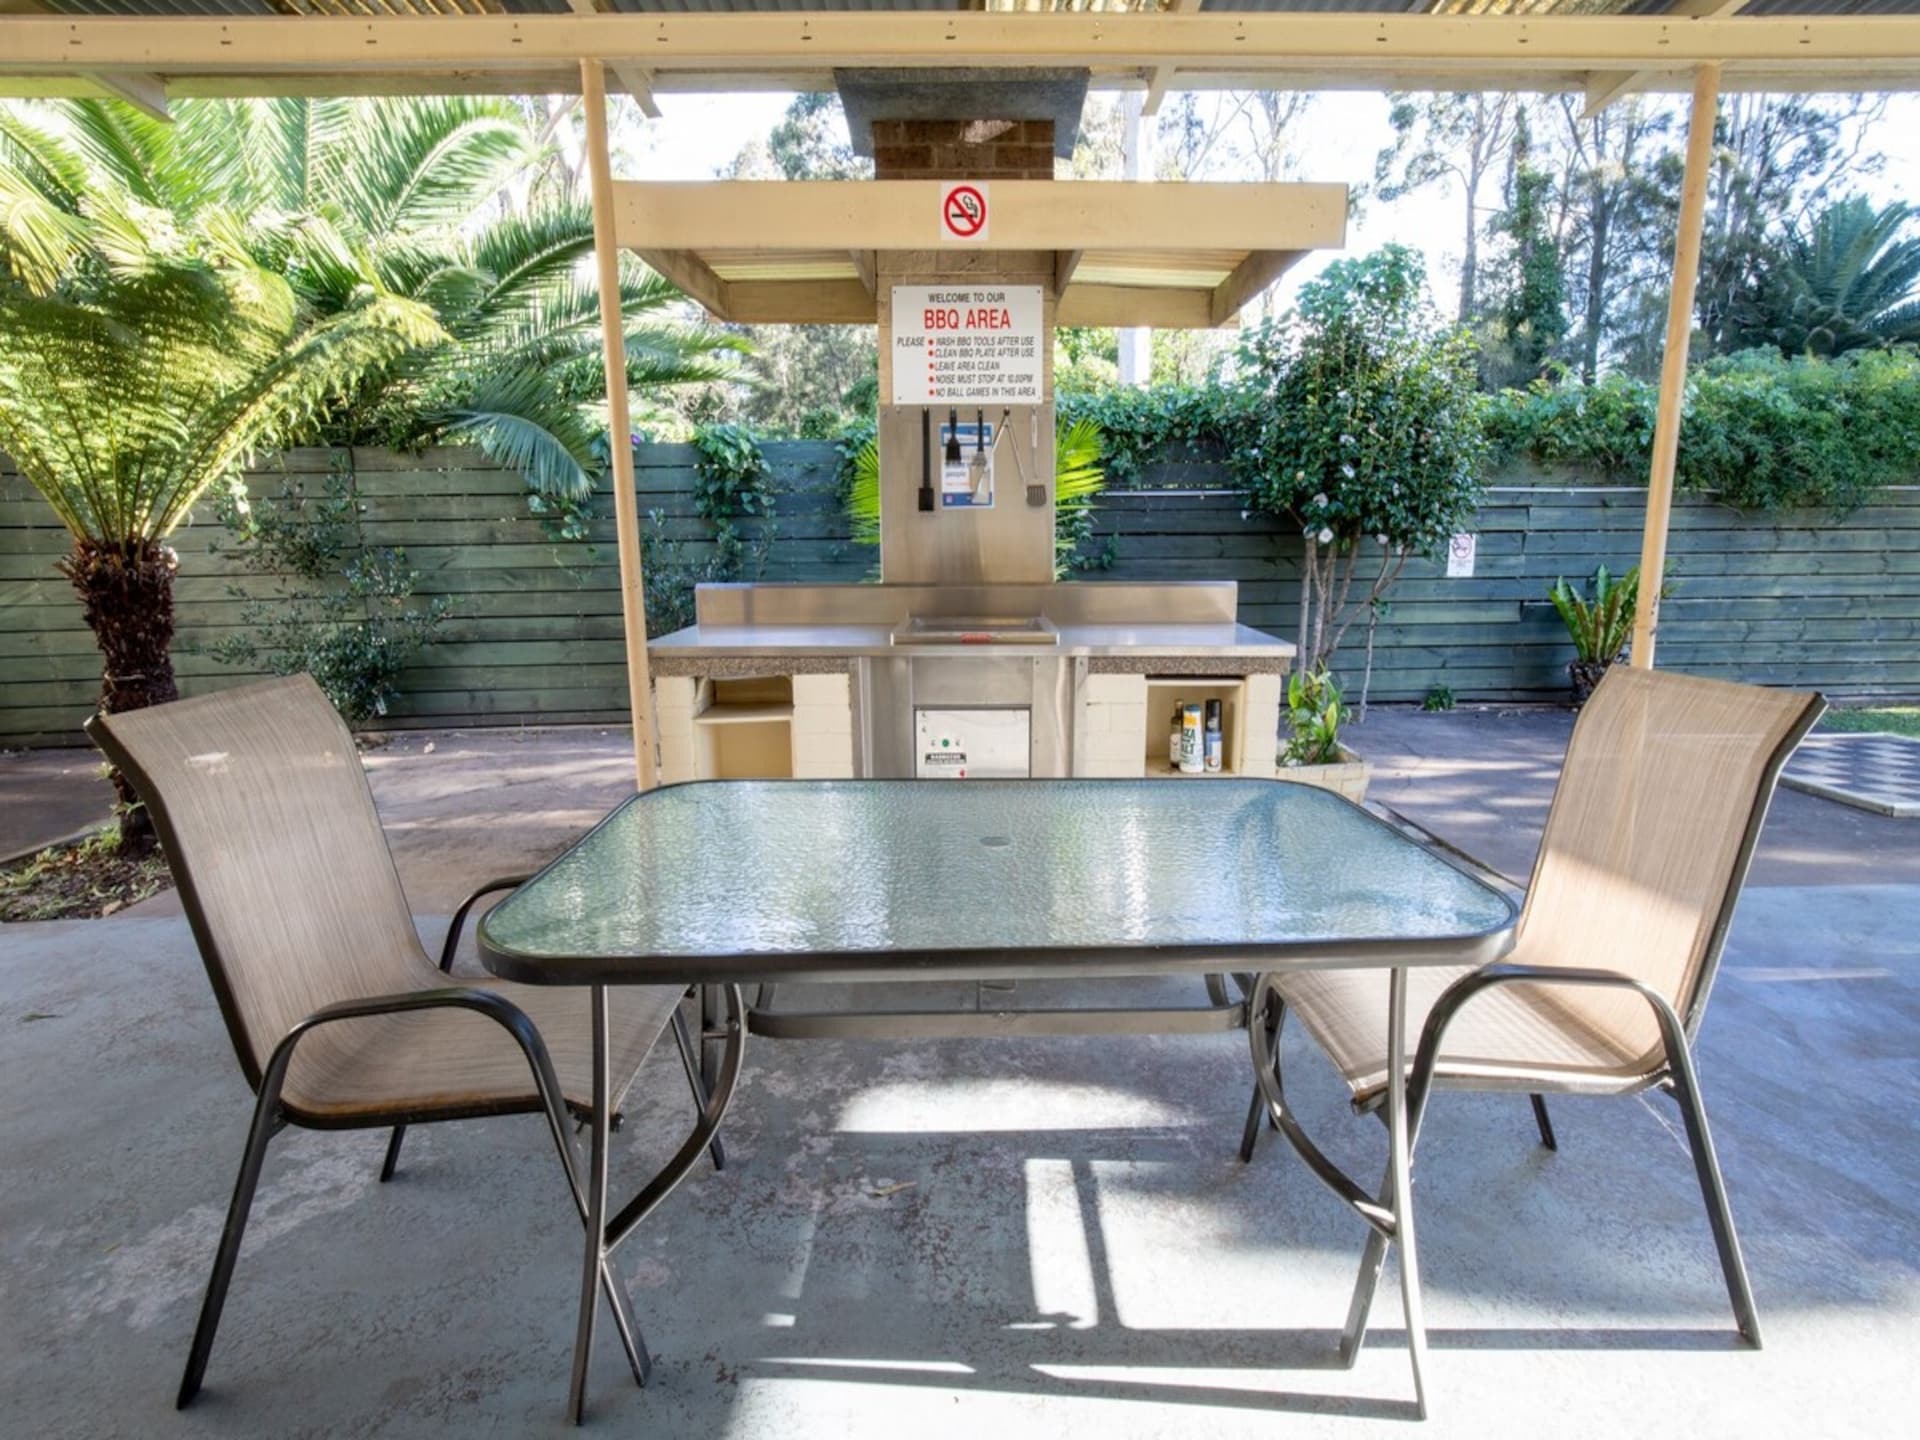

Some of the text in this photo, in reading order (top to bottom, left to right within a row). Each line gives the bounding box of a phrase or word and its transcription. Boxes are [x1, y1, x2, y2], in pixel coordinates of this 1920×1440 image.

[928, 292, 1006, 303] WELCOME TO OUR
[924, 308, 1011, 329] BBQ AREA
[897, 336, 1034, 347] PLEASE WASH BBQ TOOLS AFTER USE
[935, 347, 1034, 358] CLEAN BBQ PLATE AFTER USE
[935, 361, 1000, 371] LEAVE AREA CLEAN
[935, 374, 955, 384] NOISE
[957, 374, 976, 384] MUST
[977, 374, 996, 384] STOP
[997, 374, 1006, 383] AT
[936, 387, 1036, 397] NO BALL GAMES IN THIS AREA
